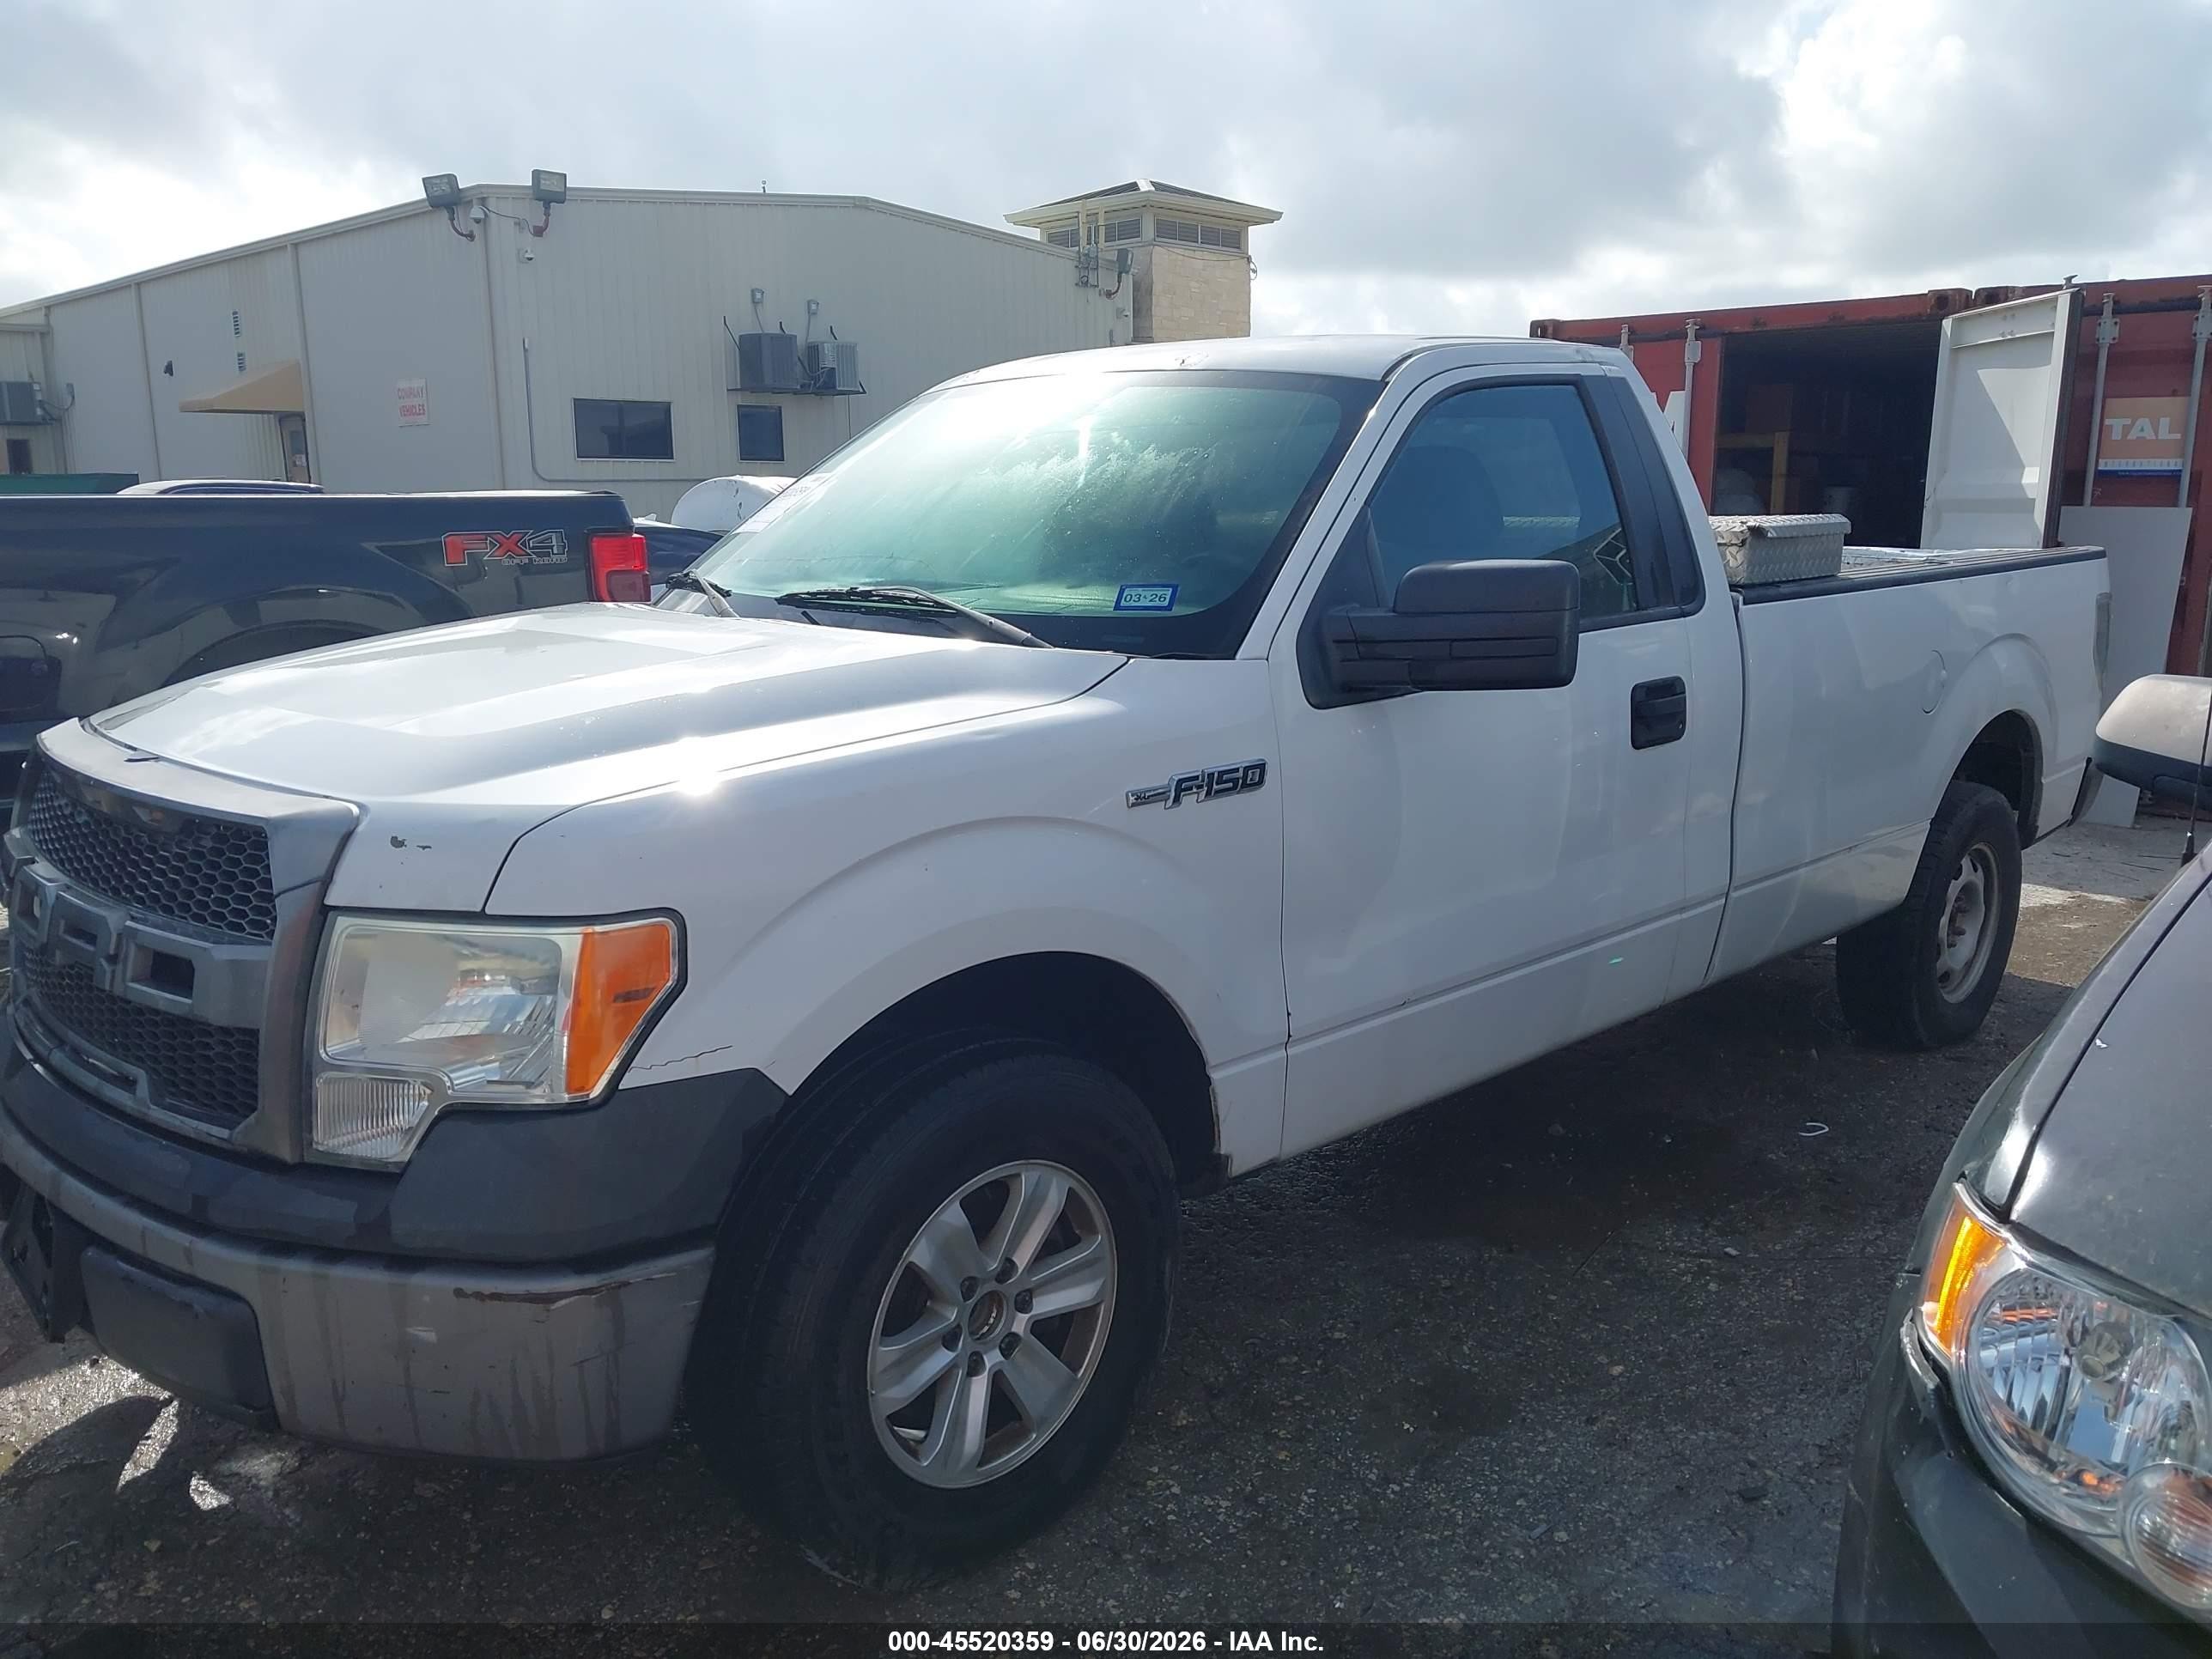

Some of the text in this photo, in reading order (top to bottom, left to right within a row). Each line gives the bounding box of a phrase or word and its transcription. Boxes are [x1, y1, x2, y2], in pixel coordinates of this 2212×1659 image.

[398, 404, 426, 417] VEHICLES
[2105, 417, 2182, 440] TAL
[441, 529, 568, 567] FX4
